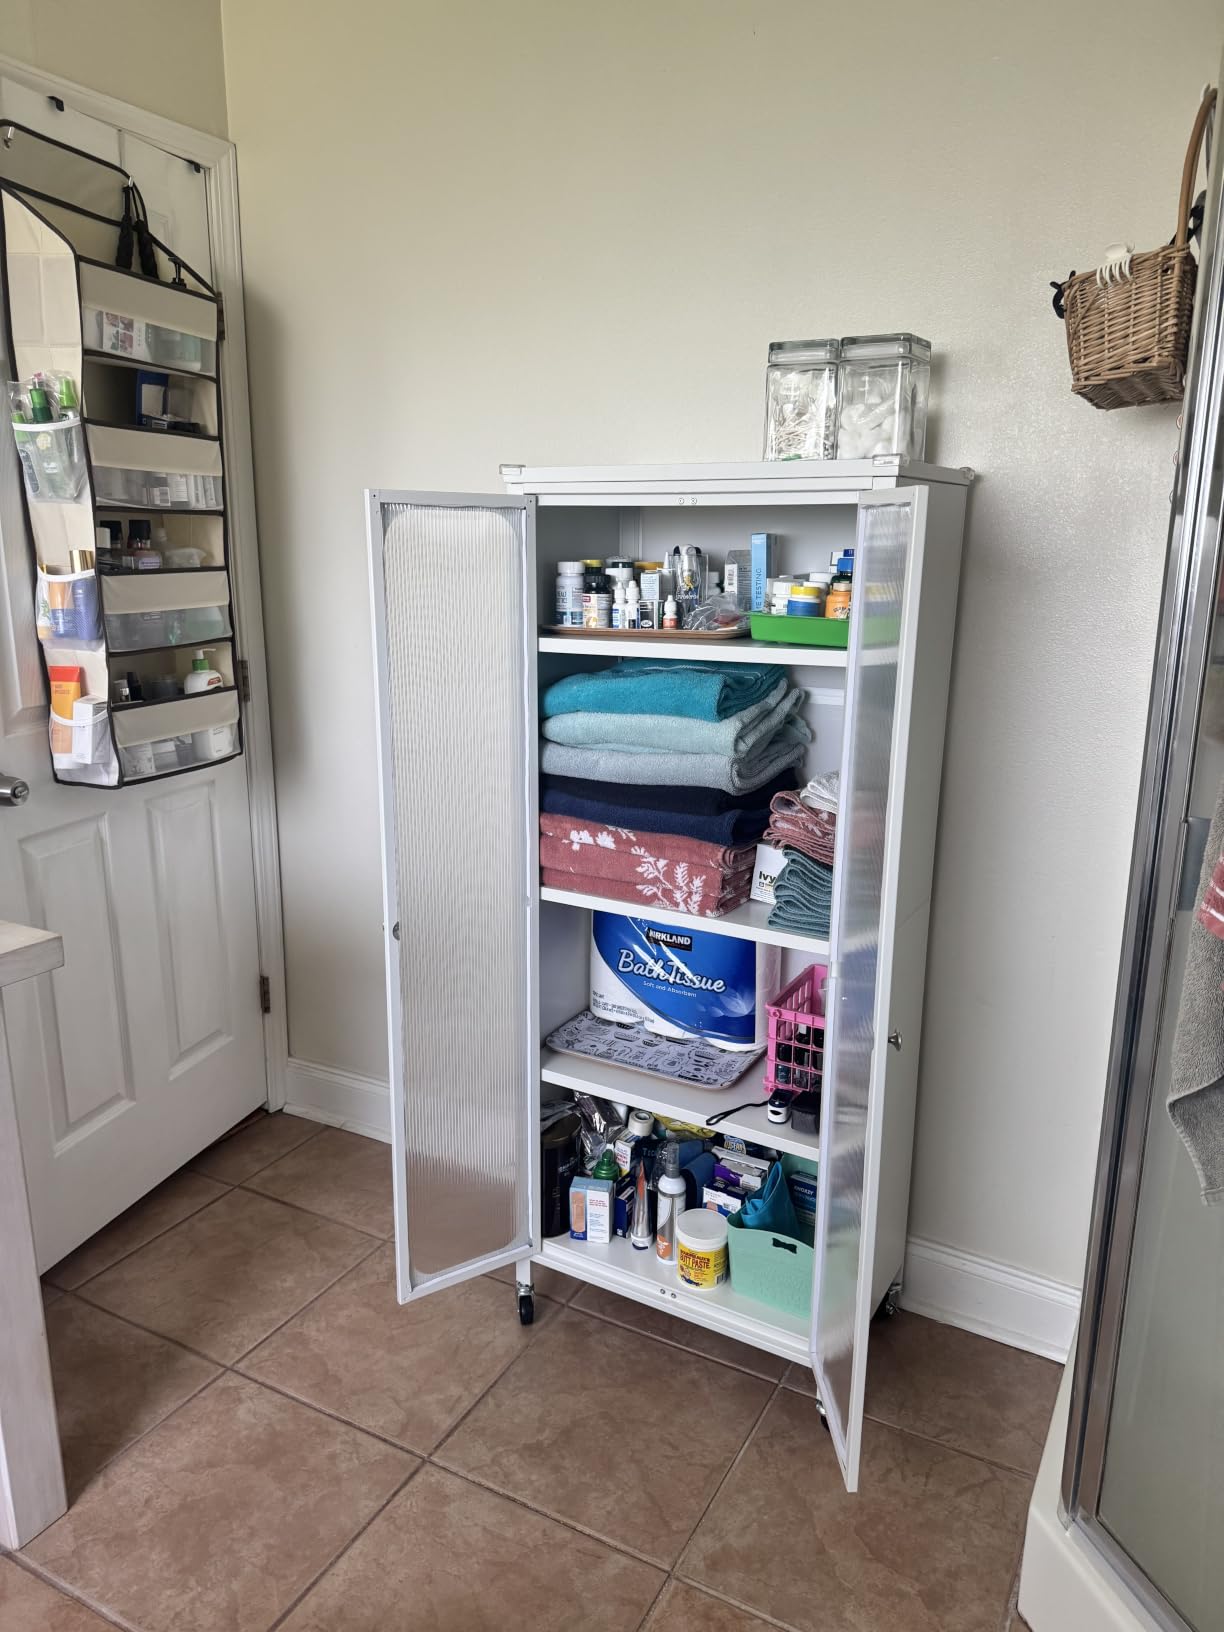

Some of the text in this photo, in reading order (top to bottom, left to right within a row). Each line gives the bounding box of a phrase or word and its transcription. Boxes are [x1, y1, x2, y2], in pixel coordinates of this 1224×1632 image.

[648, 929, 691, 945] KIRKLAND
[618, 949, 726, 992] Bath Tissue
[643, 980, 655, 990] Soft
[668, 987, 697, 998] Absorbent
[691, 1257, 711, 1270] PASTE
